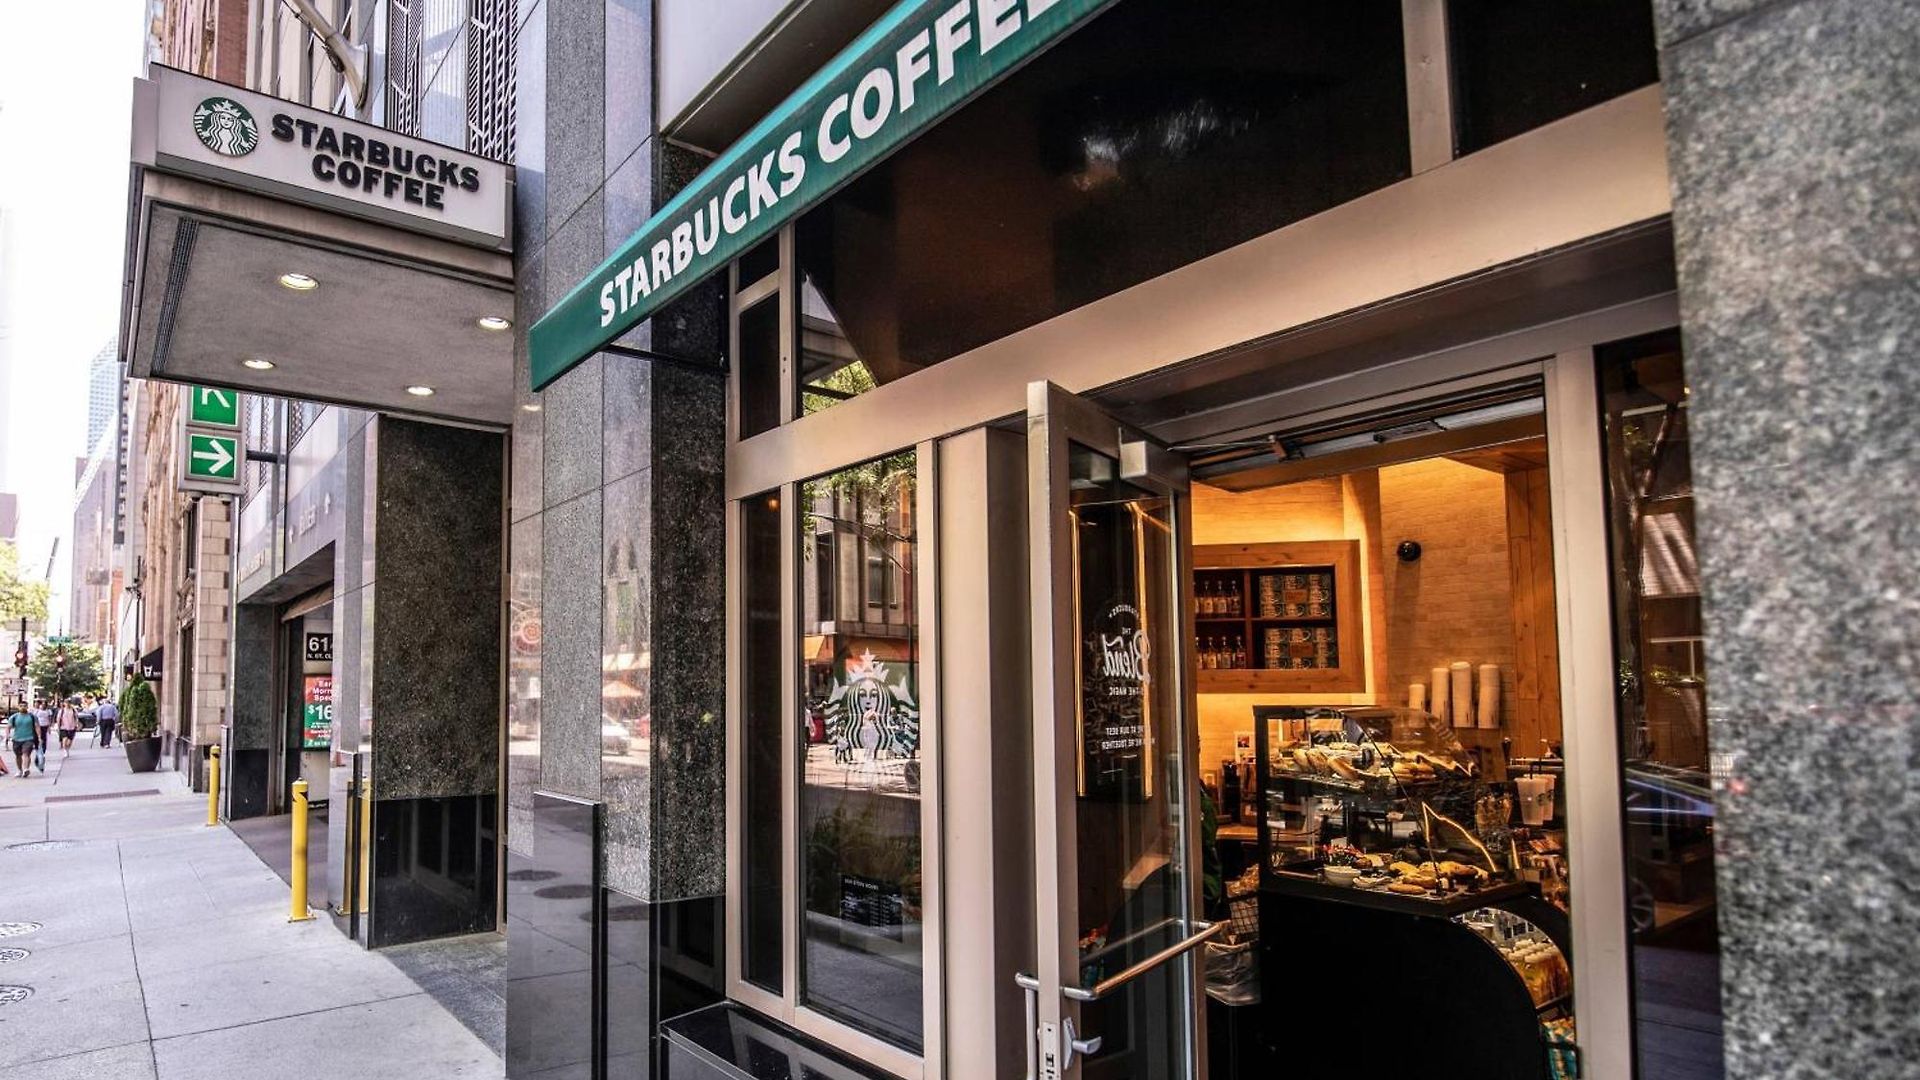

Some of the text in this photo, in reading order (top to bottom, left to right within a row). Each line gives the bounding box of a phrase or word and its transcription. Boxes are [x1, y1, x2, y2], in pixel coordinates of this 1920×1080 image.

[271, 113, 480, 193] STARBUCKS
[312, 153, 445, 211] COFFEE
[600, 0, 1062, 328] STARBUCKS COFFE
[309, 637, 333, 652] 61
